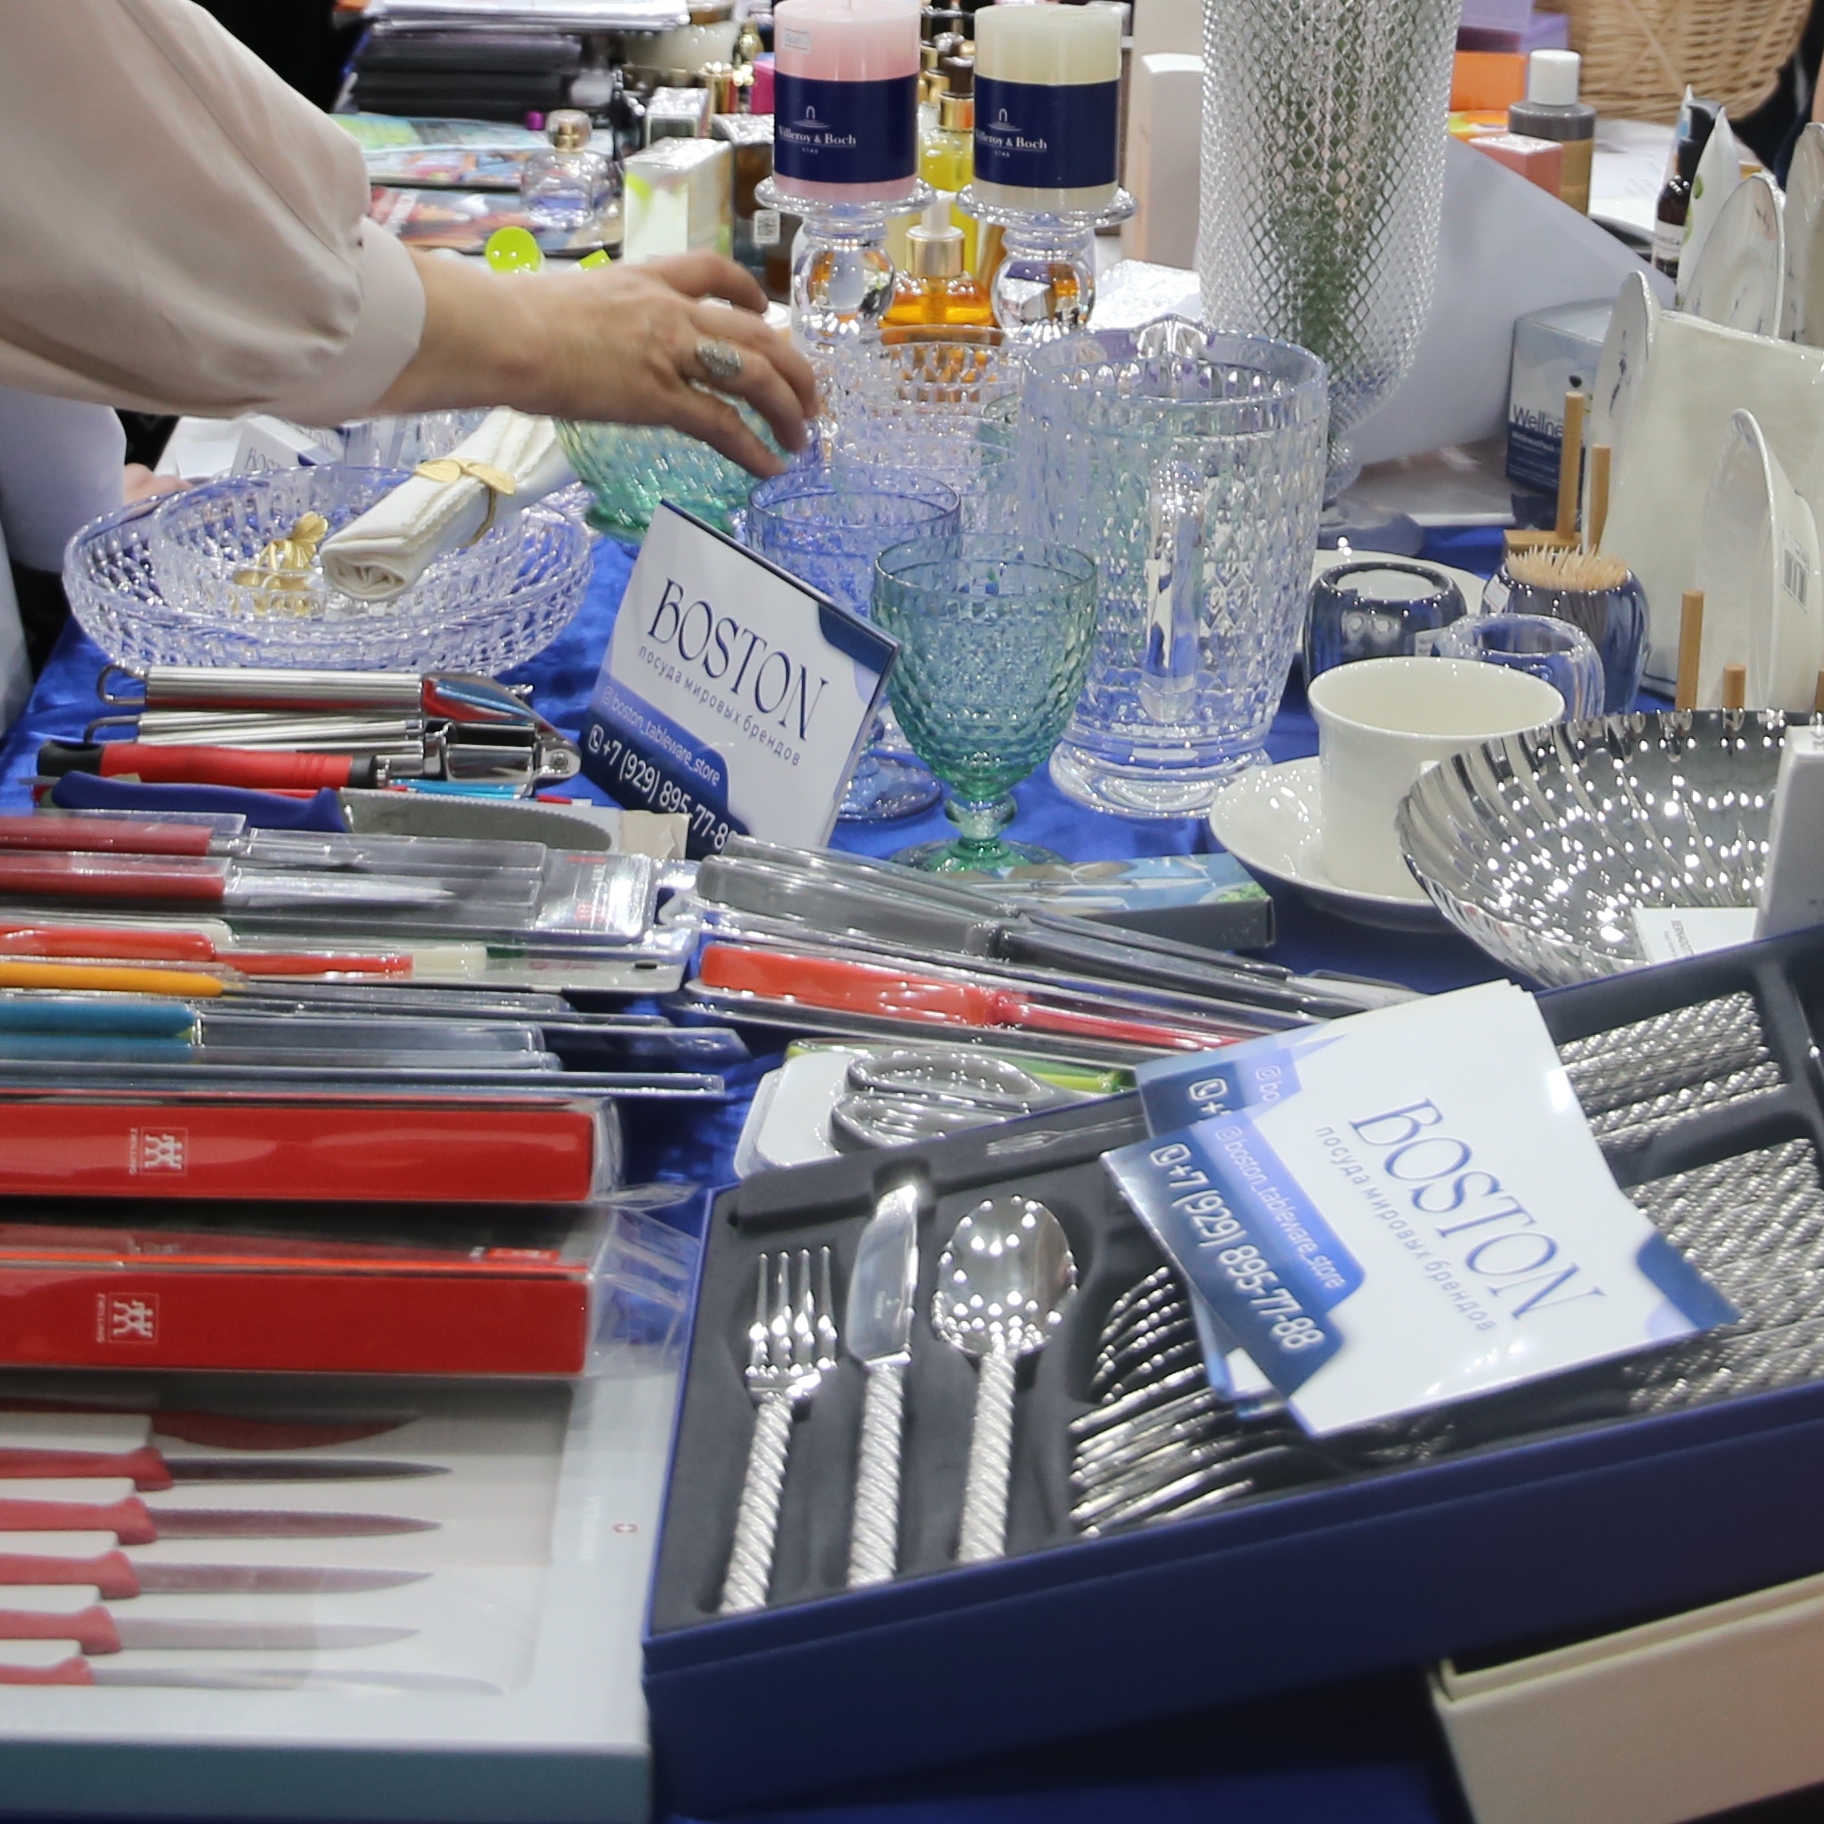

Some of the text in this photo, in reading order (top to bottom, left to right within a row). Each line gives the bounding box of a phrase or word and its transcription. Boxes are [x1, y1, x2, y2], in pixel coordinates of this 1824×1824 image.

[813, 133, 823, 145] &
[825, 132, 858, 147] Boch
[1005, 136, 1014, 147] &
[1016, 134, 1048, 150] Boch
[638, 644, 802, 767] посуда мировых брендов
[647, 577, 830, 742] BOSTON
[601, 737, 622, 768] +7
[619, 748, 661, 804] (929)
[610, 691, 721, 787] boston_tableware_store
[1166, 1162, 1327, 1352] +7 (929) 895-77-88
[1224, 1137, 1348, 1294] boston_tableware_store
[1313, 1124, 1498, 1333] посуда мировых брендов
[1348, 1097, 1608, 1322] BOSTON
